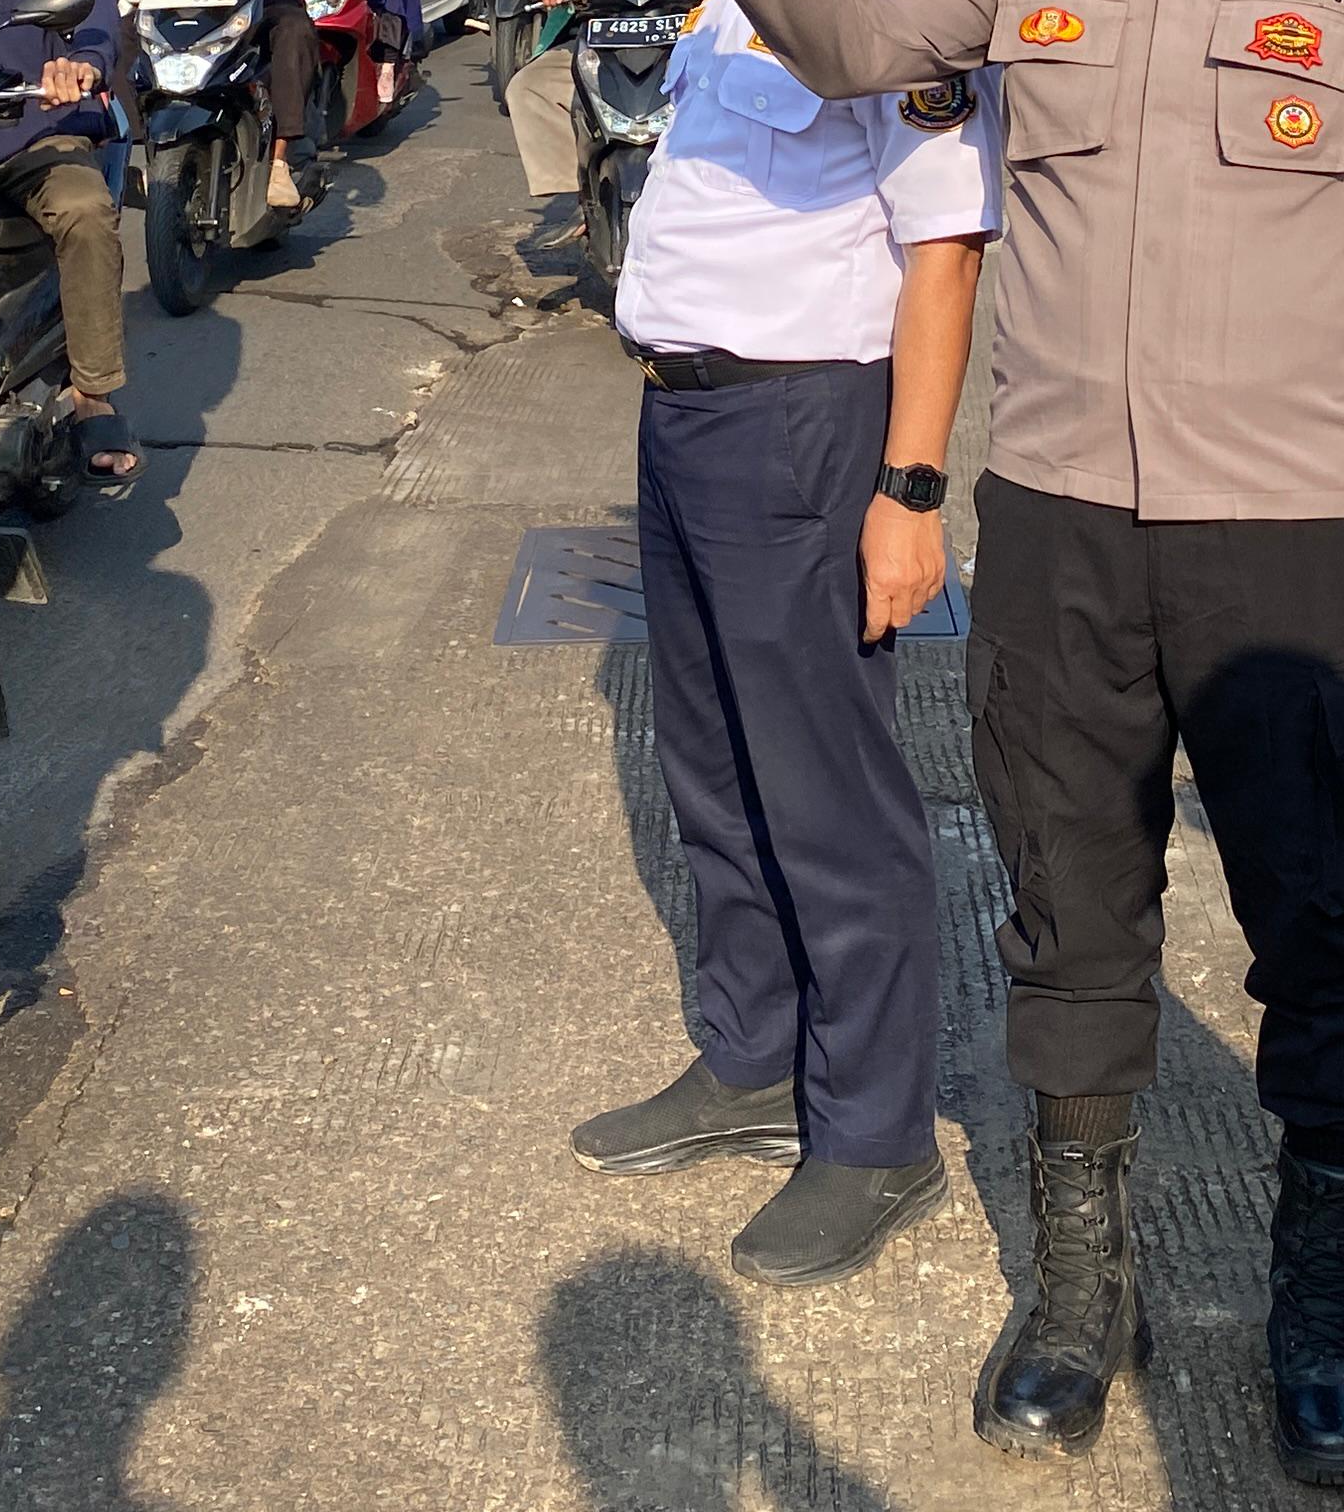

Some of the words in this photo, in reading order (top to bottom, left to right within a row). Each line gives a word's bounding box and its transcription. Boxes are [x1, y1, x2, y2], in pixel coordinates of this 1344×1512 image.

[592, 22, 602, 33] B
[610, 21, 648, 33] 4825
[656, 16, 686, 31] SLW
